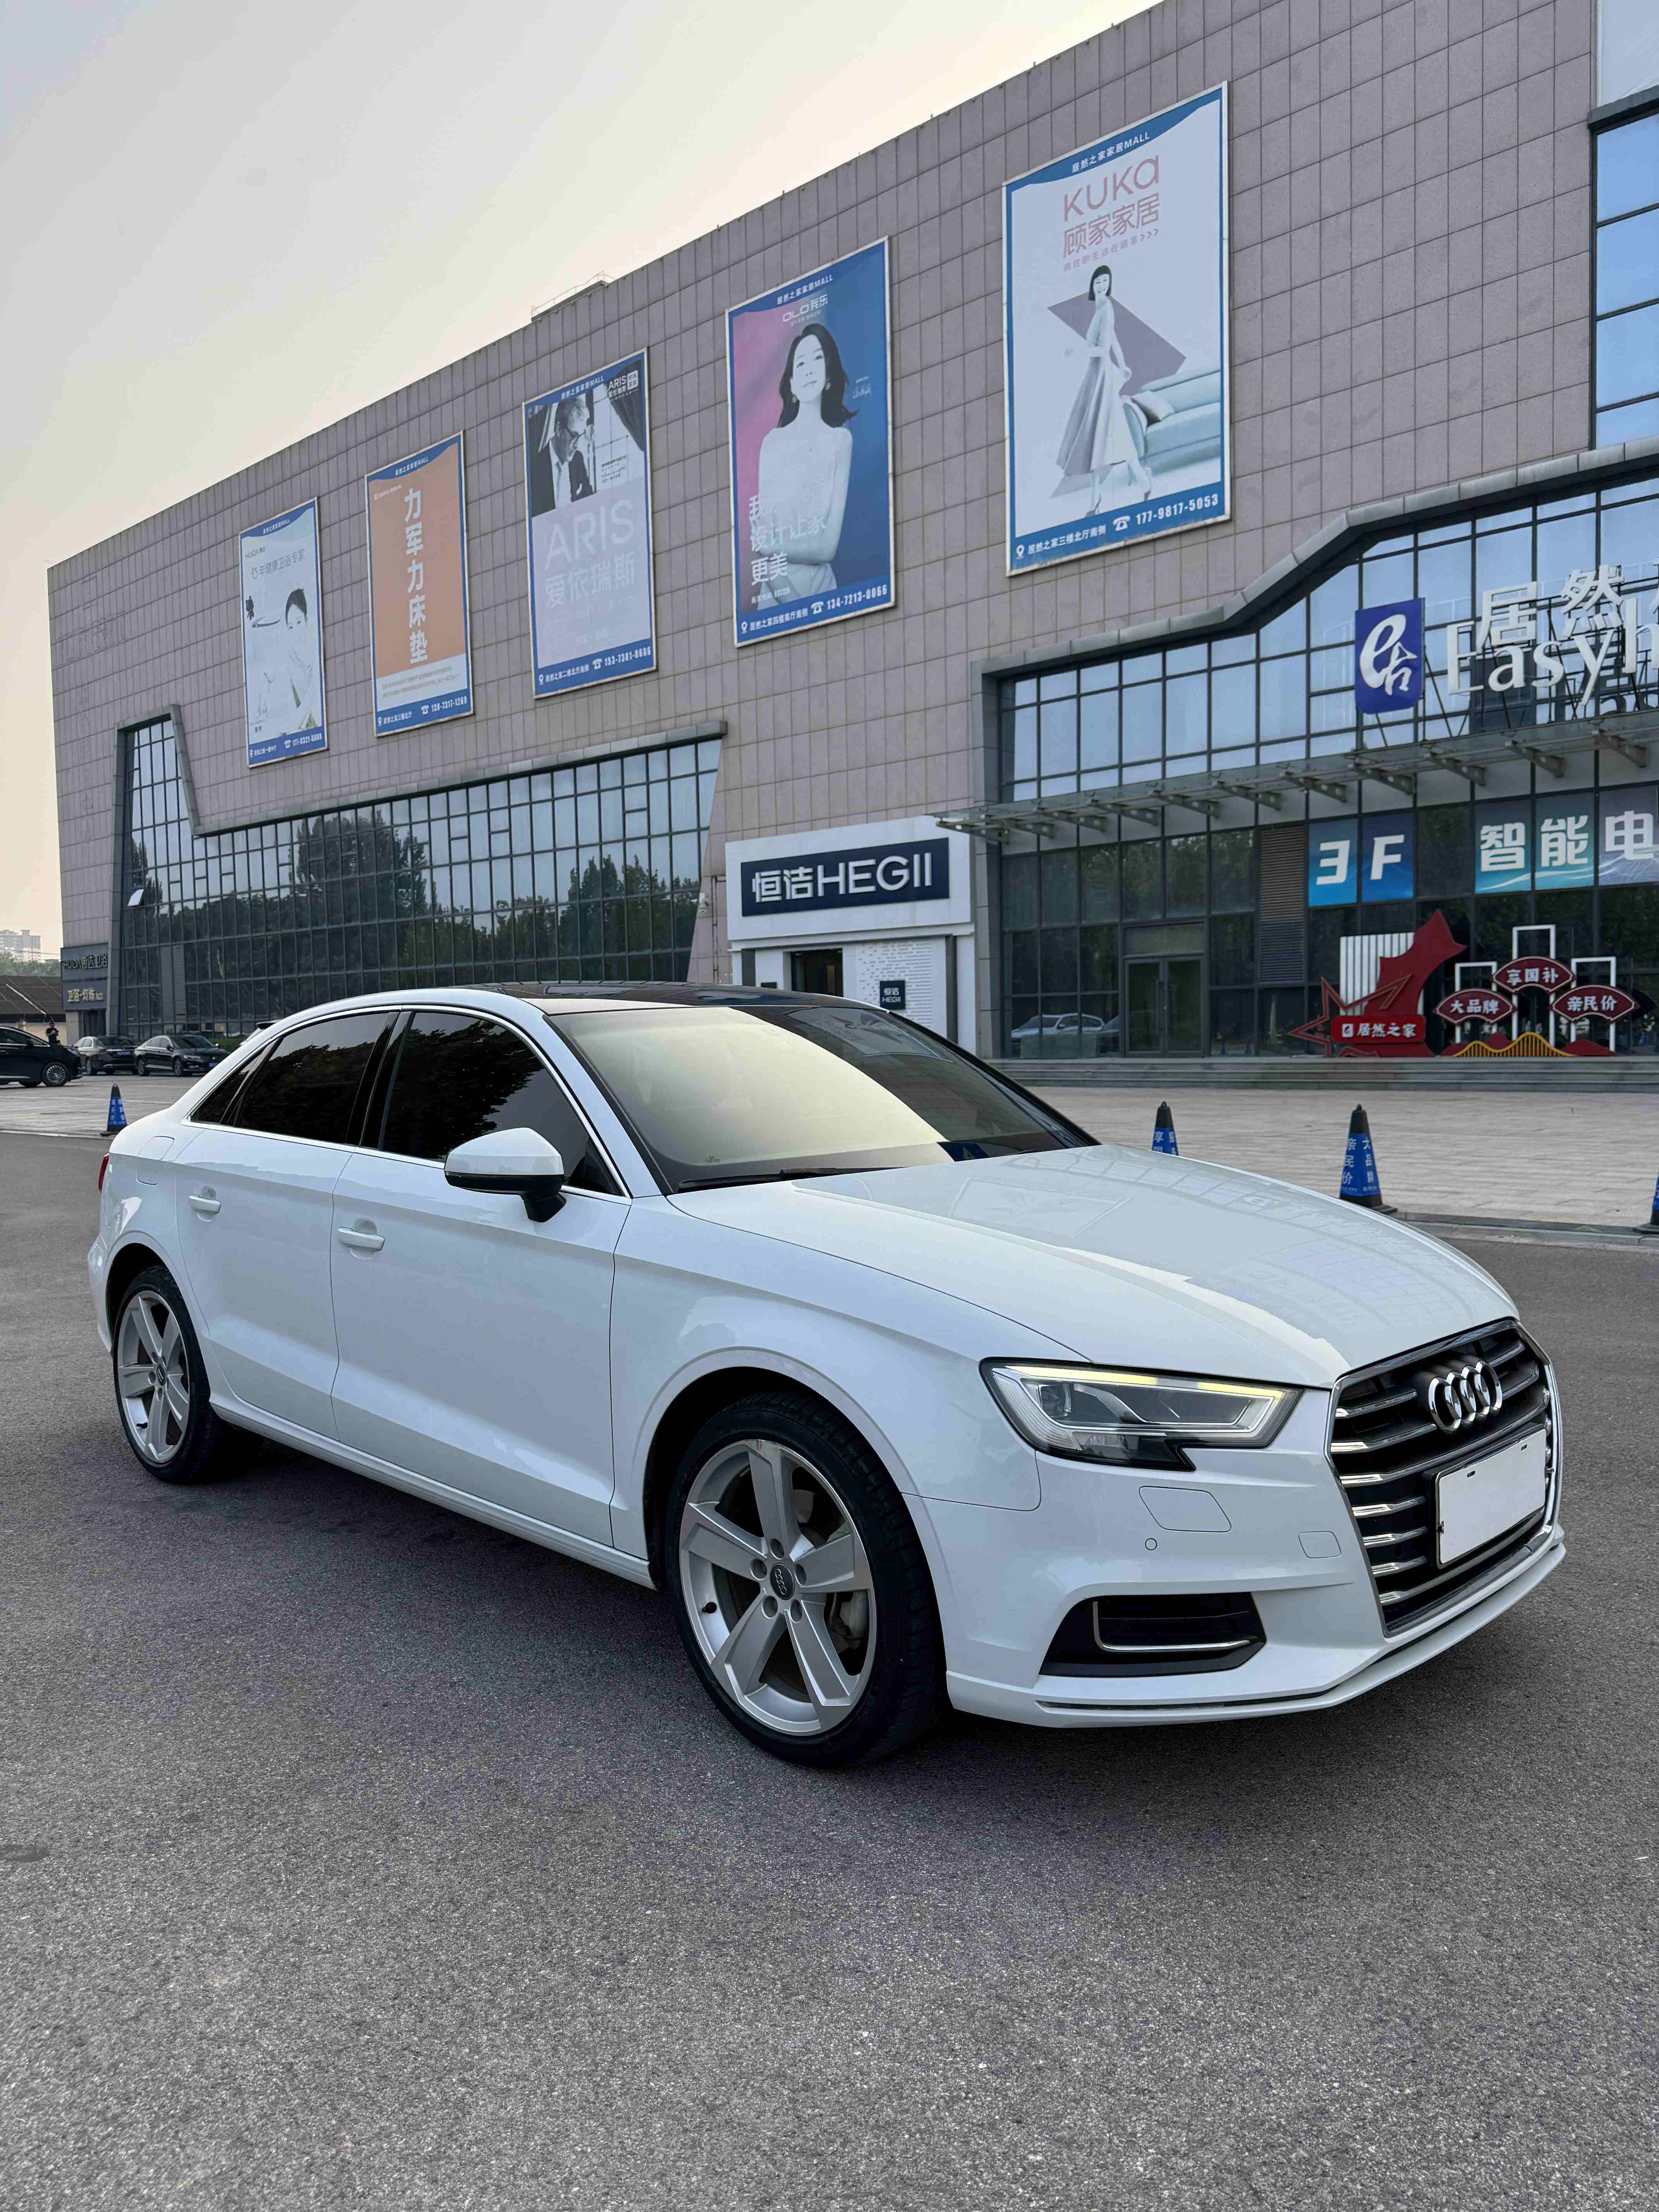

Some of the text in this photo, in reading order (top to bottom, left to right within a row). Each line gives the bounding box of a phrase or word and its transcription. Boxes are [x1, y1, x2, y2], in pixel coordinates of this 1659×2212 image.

[1072, 131, 1151, 173] 居然之家家居MALL
[1063, 192, 1160, 258] 顾家家居
[608, 375, 627, 391] ARIS
[1136, 493, 1218, 525] 177-9817-5053
[544, 499, 634, 570] ARIS
[545, 551, 635, 609] 爱依瑞斯
[751, 551, 788, 586] 更美
[1476, 558, 1659, 653] 居然
[1316, 834, 1405, 885] 3F
[1480, 810, 1654, 873] 智能电
[1507, 967, 1559, 986] 享国补
[1450, 999, 1500, 1015] 大品牌
[1567, 995, 1618, 1012] 亲民价
[1357, 1022, 1417, 1038] 居然之家
